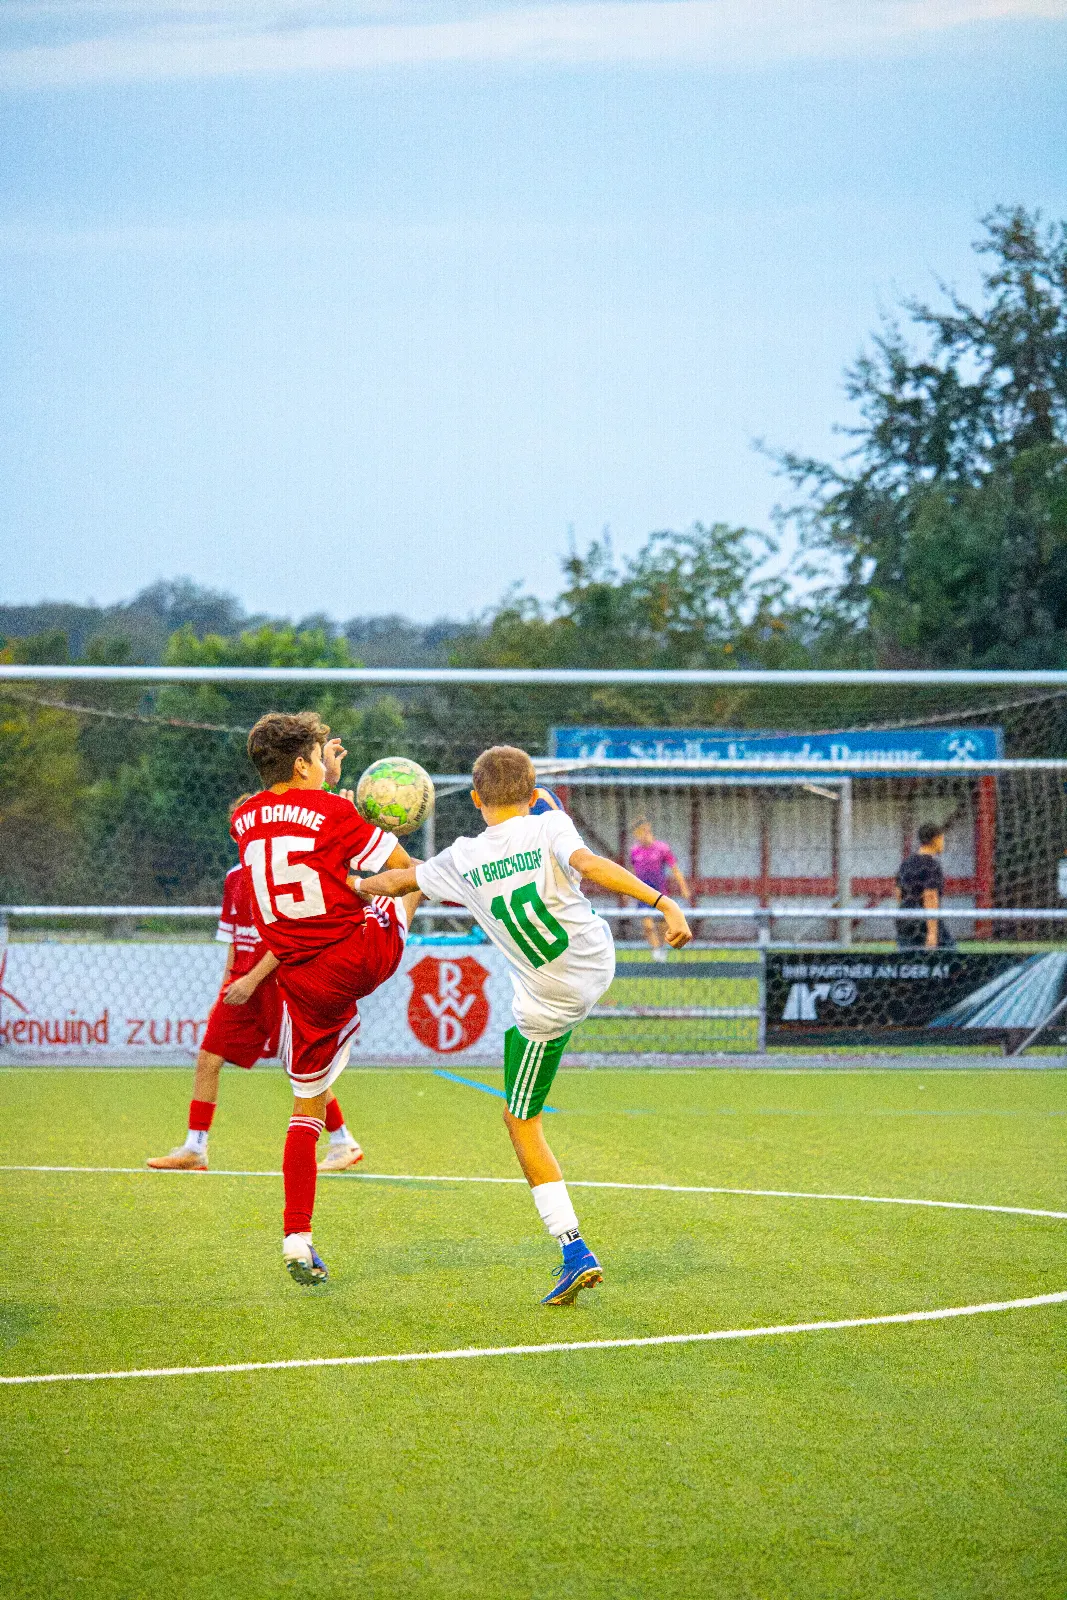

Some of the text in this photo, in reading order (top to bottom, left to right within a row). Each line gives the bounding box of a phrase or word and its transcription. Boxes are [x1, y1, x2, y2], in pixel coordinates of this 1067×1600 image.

[235, 804, 326, 837] RW DAMME
[244, 836, 326, 925] 15
[491, 881, 568, 969] 10
